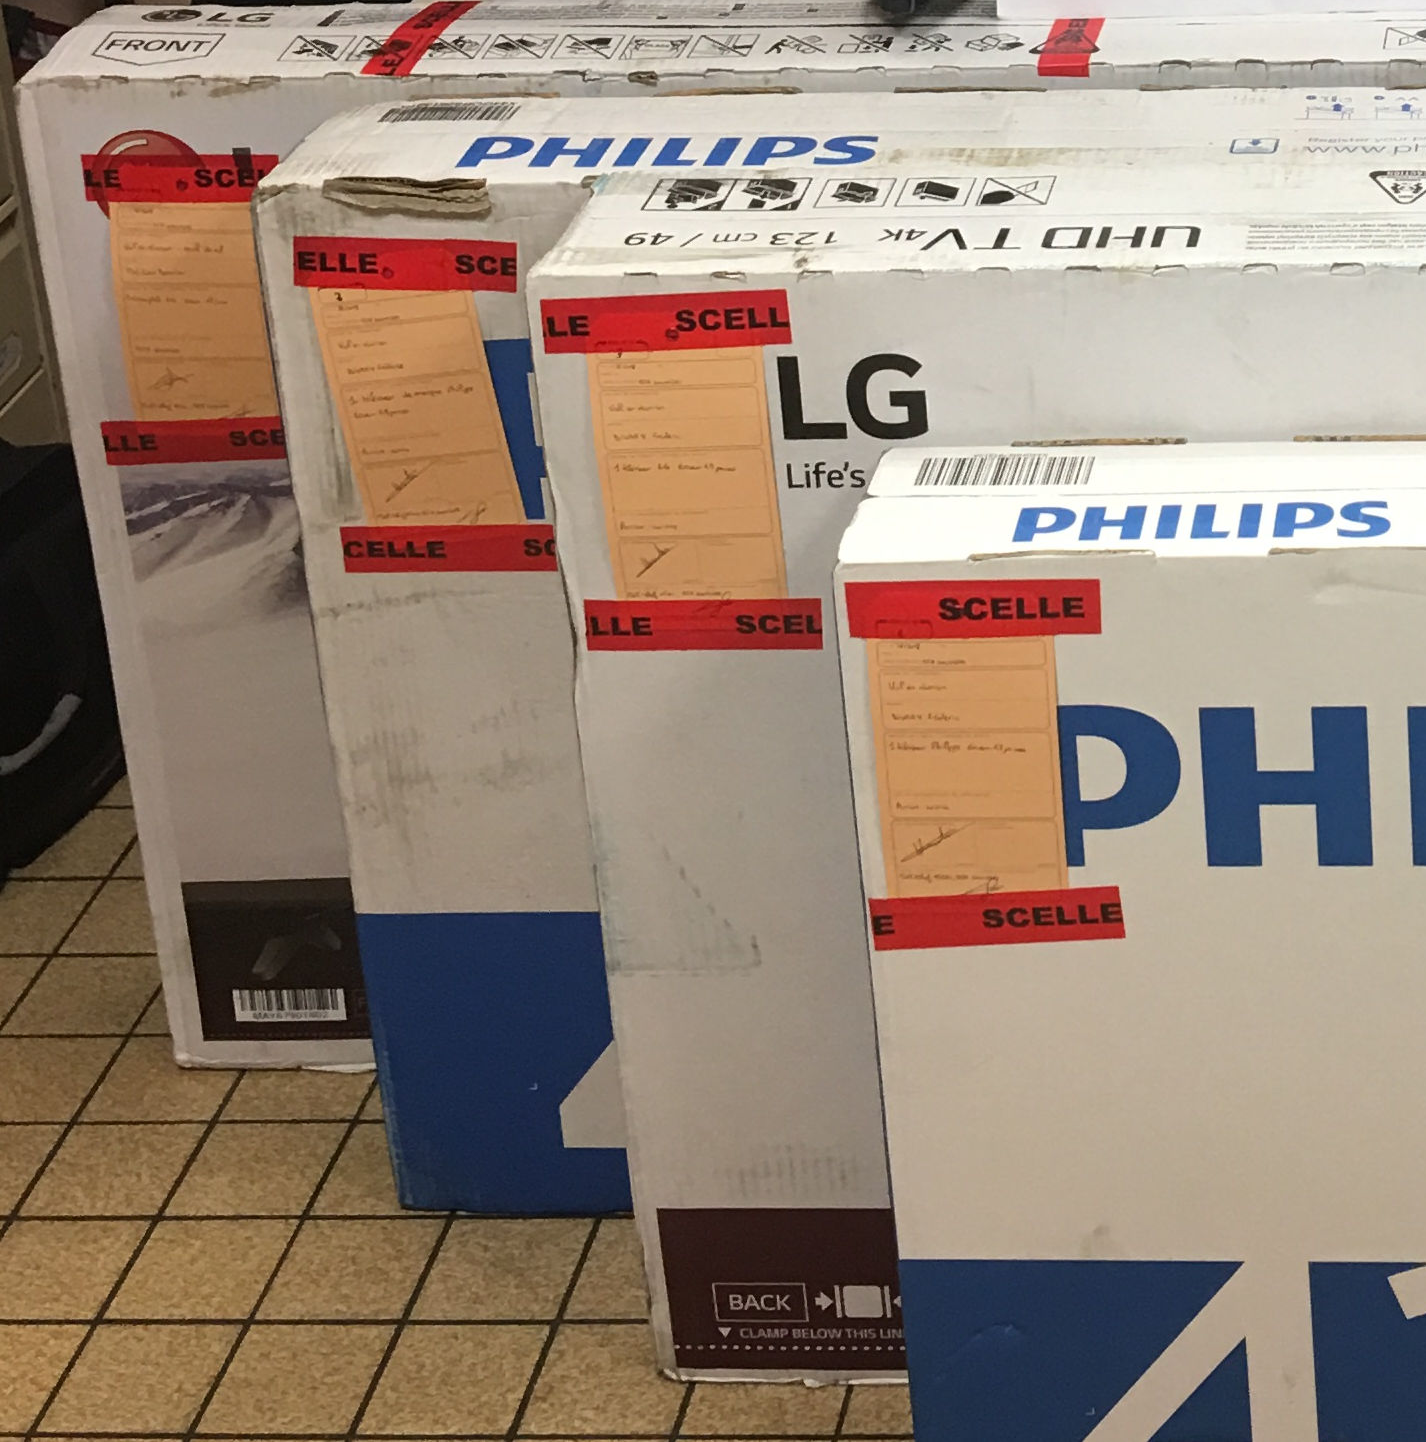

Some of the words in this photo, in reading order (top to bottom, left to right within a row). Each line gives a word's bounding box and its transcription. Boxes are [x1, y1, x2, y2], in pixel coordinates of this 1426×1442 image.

[206, 12, 275, 23] LG
[105, 39, 212, 54] FRONT
[456, 135, 879, 168] PHILIPS
[624, 232, 675, 246] 49
[680, 232, 703, 247] /
[712, 232, 759, 243] cm
[770, 231, 838, 246] 123
[1042, 225, 1202, 249] UHD
[297, 251, 379, 274] ELLE
[455, 254, 517, 276] SCE
[543, 315, 590, 337] LE
[675, 307, 790, 332] SCELL
[777, 353, 929, 440] LG
[786, 462, 866, 490] Life's
[1011, 500, 1391, 543] PHILIPS
[343, 540, 447, 558] CELLE
[938, 596, 1087, 622] SCELLE
[586, 616, 653, 636] LLE
[873, 915, 895, 936] E
[982, 902, 1123, 928] SCELLE
[729, 1294, 791, 1311] BACK
[740, 1327, 789, 1339] CLAMP
[792, 1328, 842, 1339] BELOW
[845, 1328, 877, 1339] THIS
[879, 1328, 904, 1340] LIN
